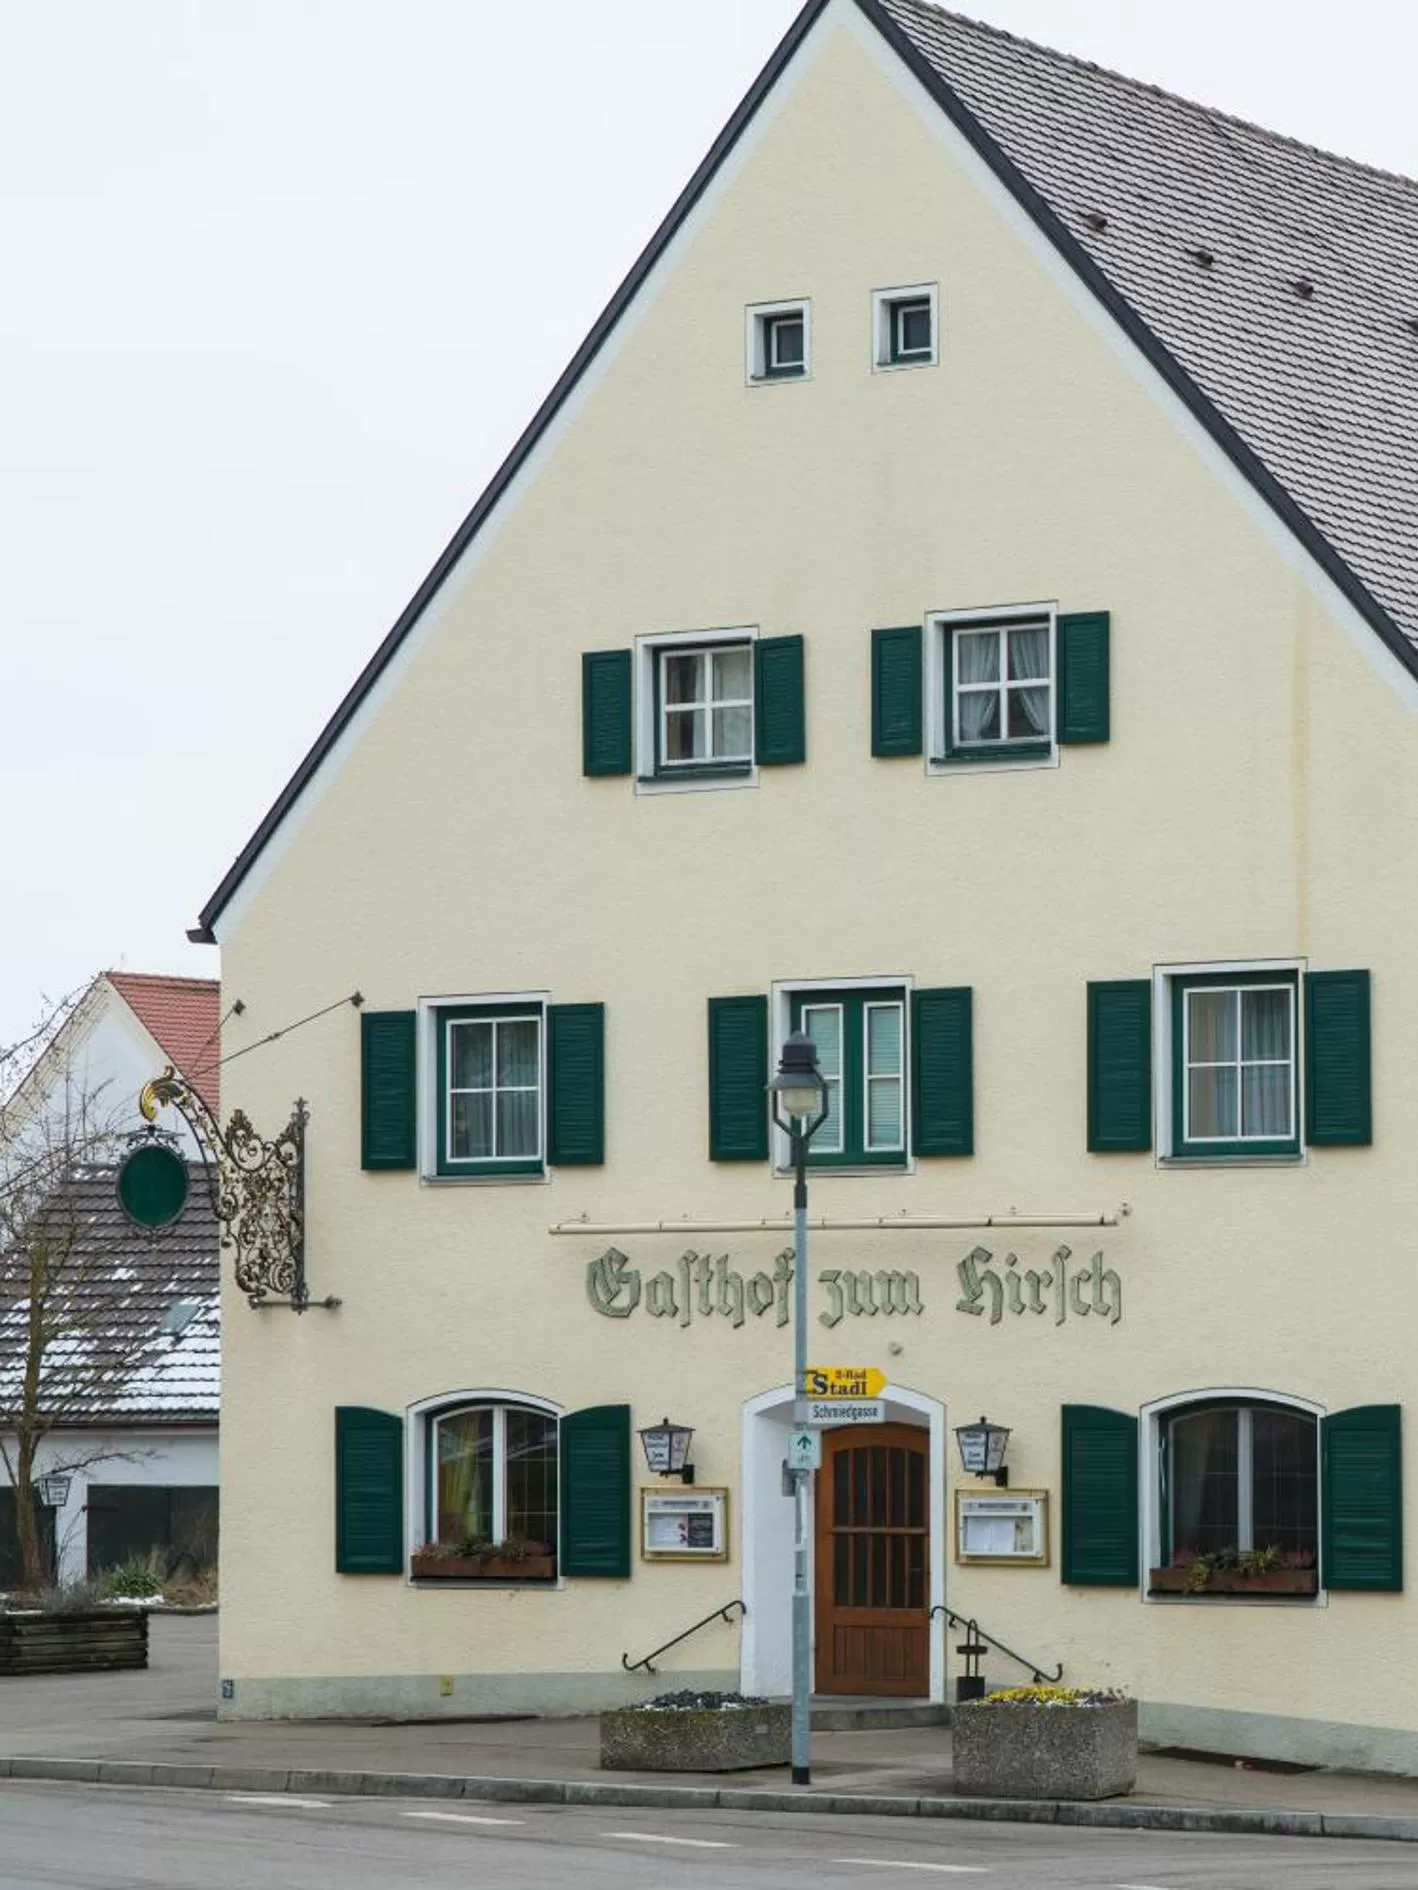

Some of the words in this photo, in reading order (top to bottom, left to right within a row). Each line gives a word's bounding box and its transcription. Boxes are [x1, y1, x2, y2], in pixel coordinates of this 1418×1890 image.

[586, 1247, 796, 1329] Gasthof
[818, 1269, 925, 1329] zum
[955, 1246, 1122, 1326] Hirsch
[812, 1372, 867, 1396] Stadl
[813, 1404, 879, 1421] Schmiedgasse
